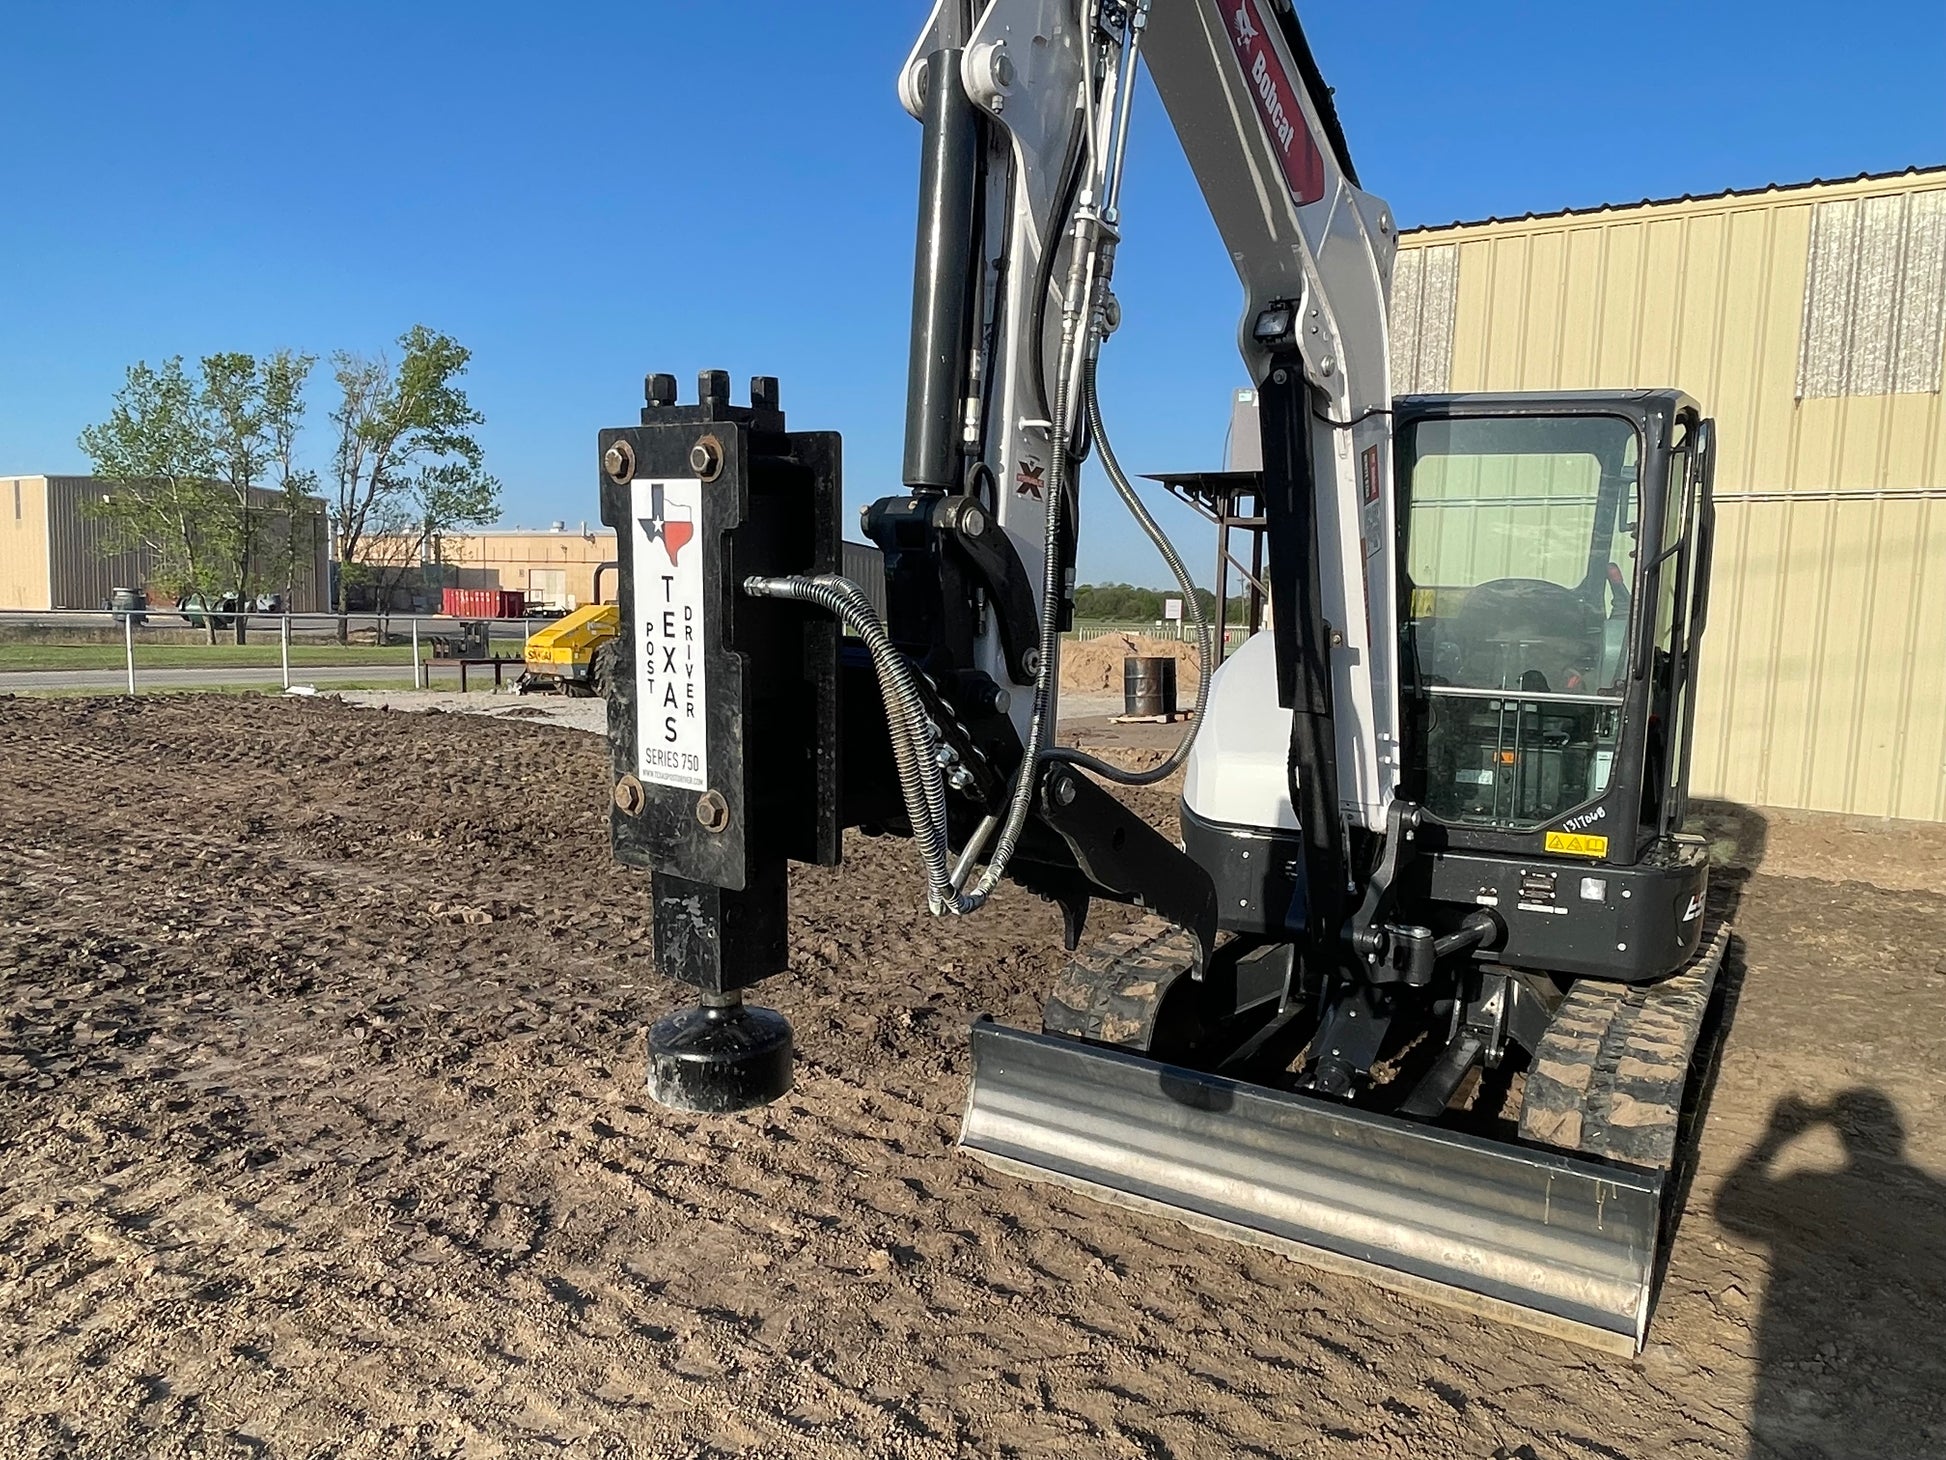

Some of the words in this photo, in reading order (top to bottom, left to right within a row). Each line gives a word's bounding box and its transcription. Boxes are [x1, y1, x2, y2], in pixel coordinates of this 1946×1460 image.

[1251, 49, 1295, 153] Bobcat
[646, 622, 655, 694] POST
[661, 575, 679, 743] TEXAS
[683, 605, 695, 719] DRIVER
[645, 747, 679, 768] SERIES
[681, 753, 699, 771] 750
